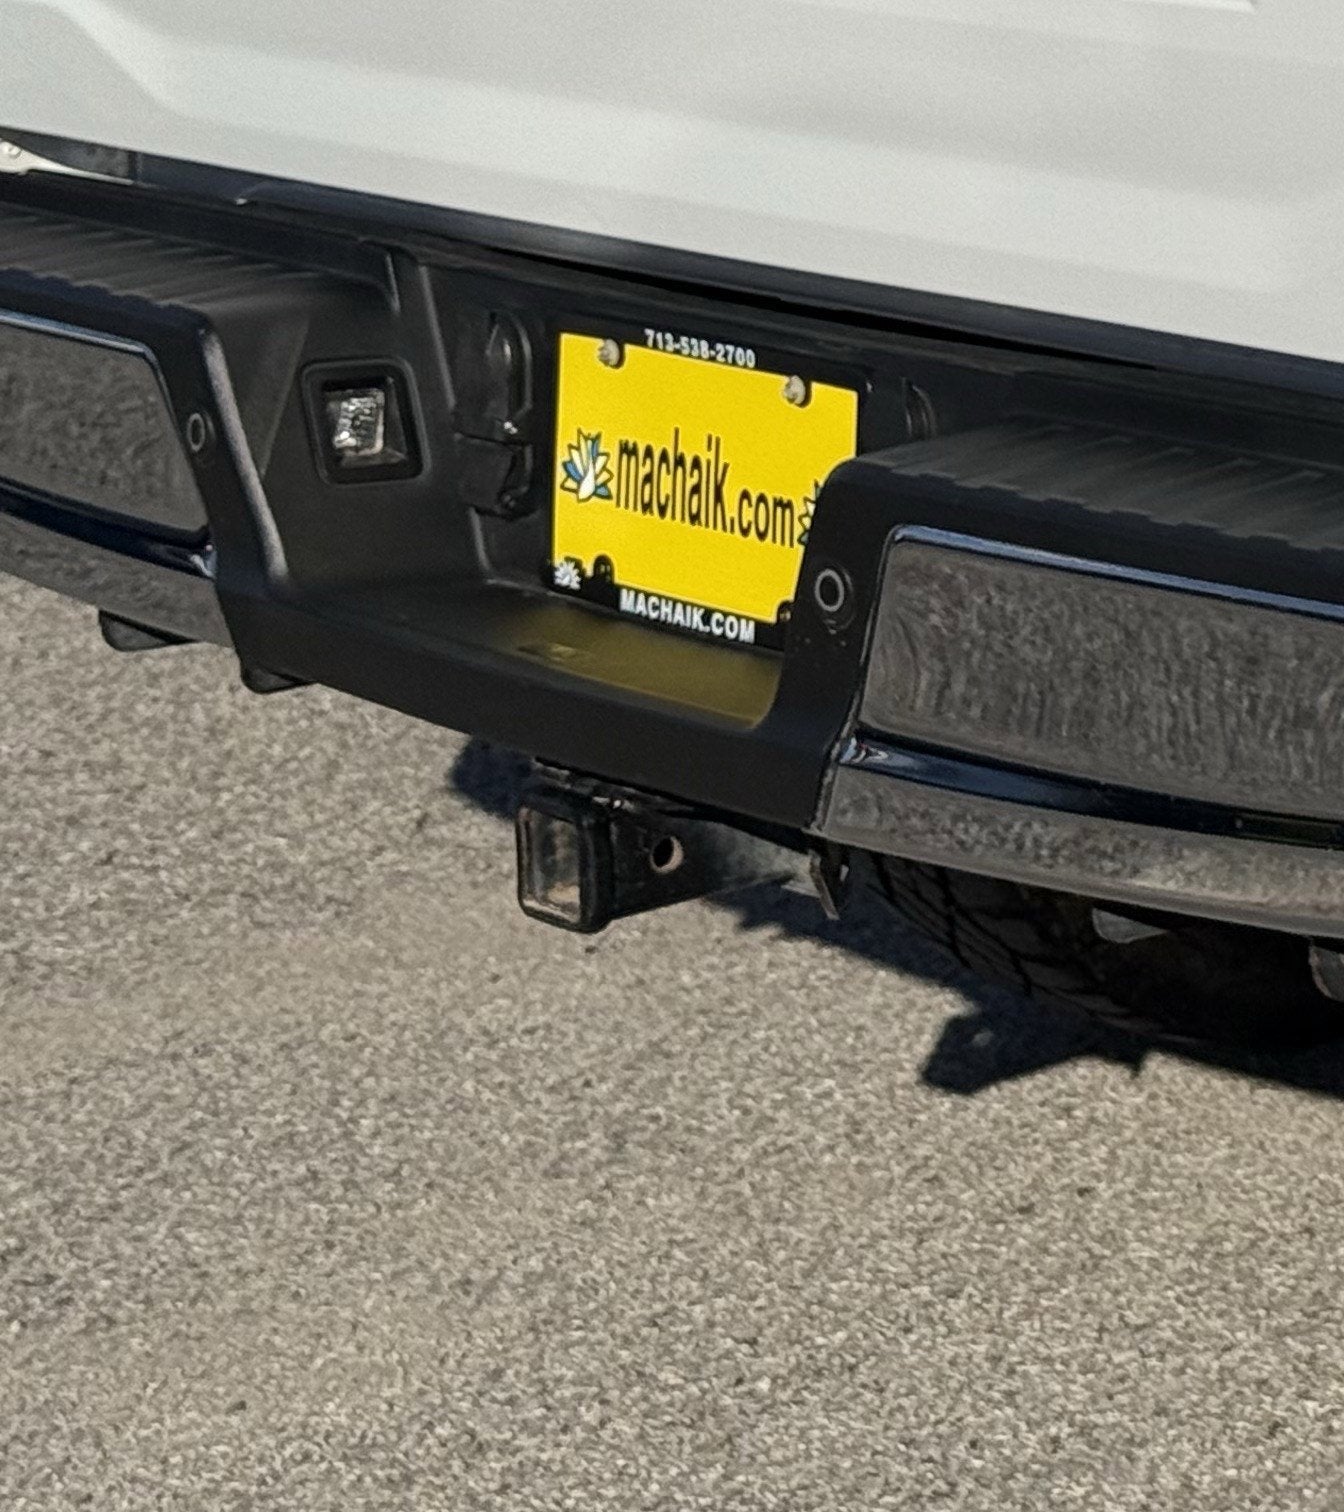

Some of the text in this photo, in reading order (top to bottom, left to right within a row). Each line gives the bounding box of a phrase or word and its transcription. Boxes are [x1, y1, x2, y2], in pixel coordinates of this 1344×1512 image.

[646, 329, 756, 368] 713-538-2700
[615, 427, 795, 548] machaik.com
[619, 589, 756, 644] MACHAIK.COM
